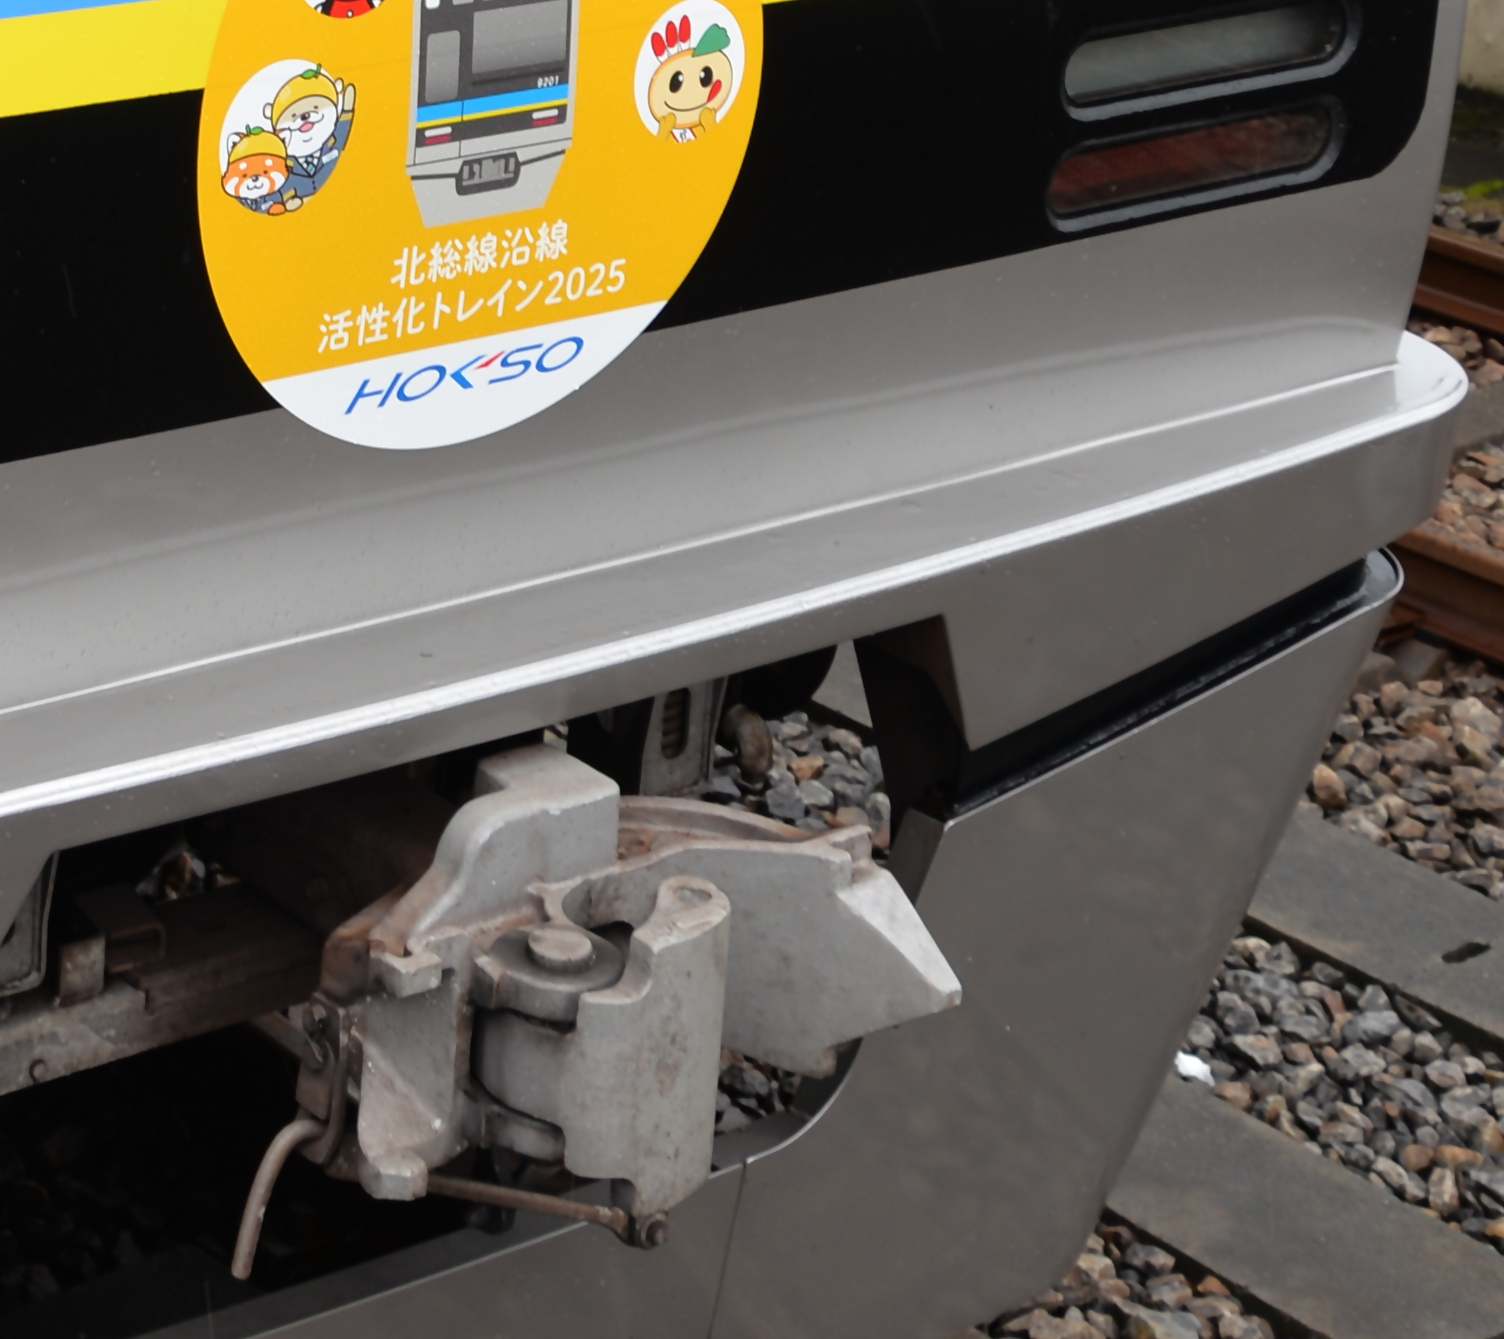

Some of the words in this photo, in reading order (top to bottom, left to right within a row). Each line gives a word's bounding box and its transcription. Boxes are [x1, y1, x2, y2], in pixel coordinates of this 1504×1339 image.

[390, 218, 570, 290] 北総線沿線
[317, 258, 628, 355] 活性化トレイン2025
